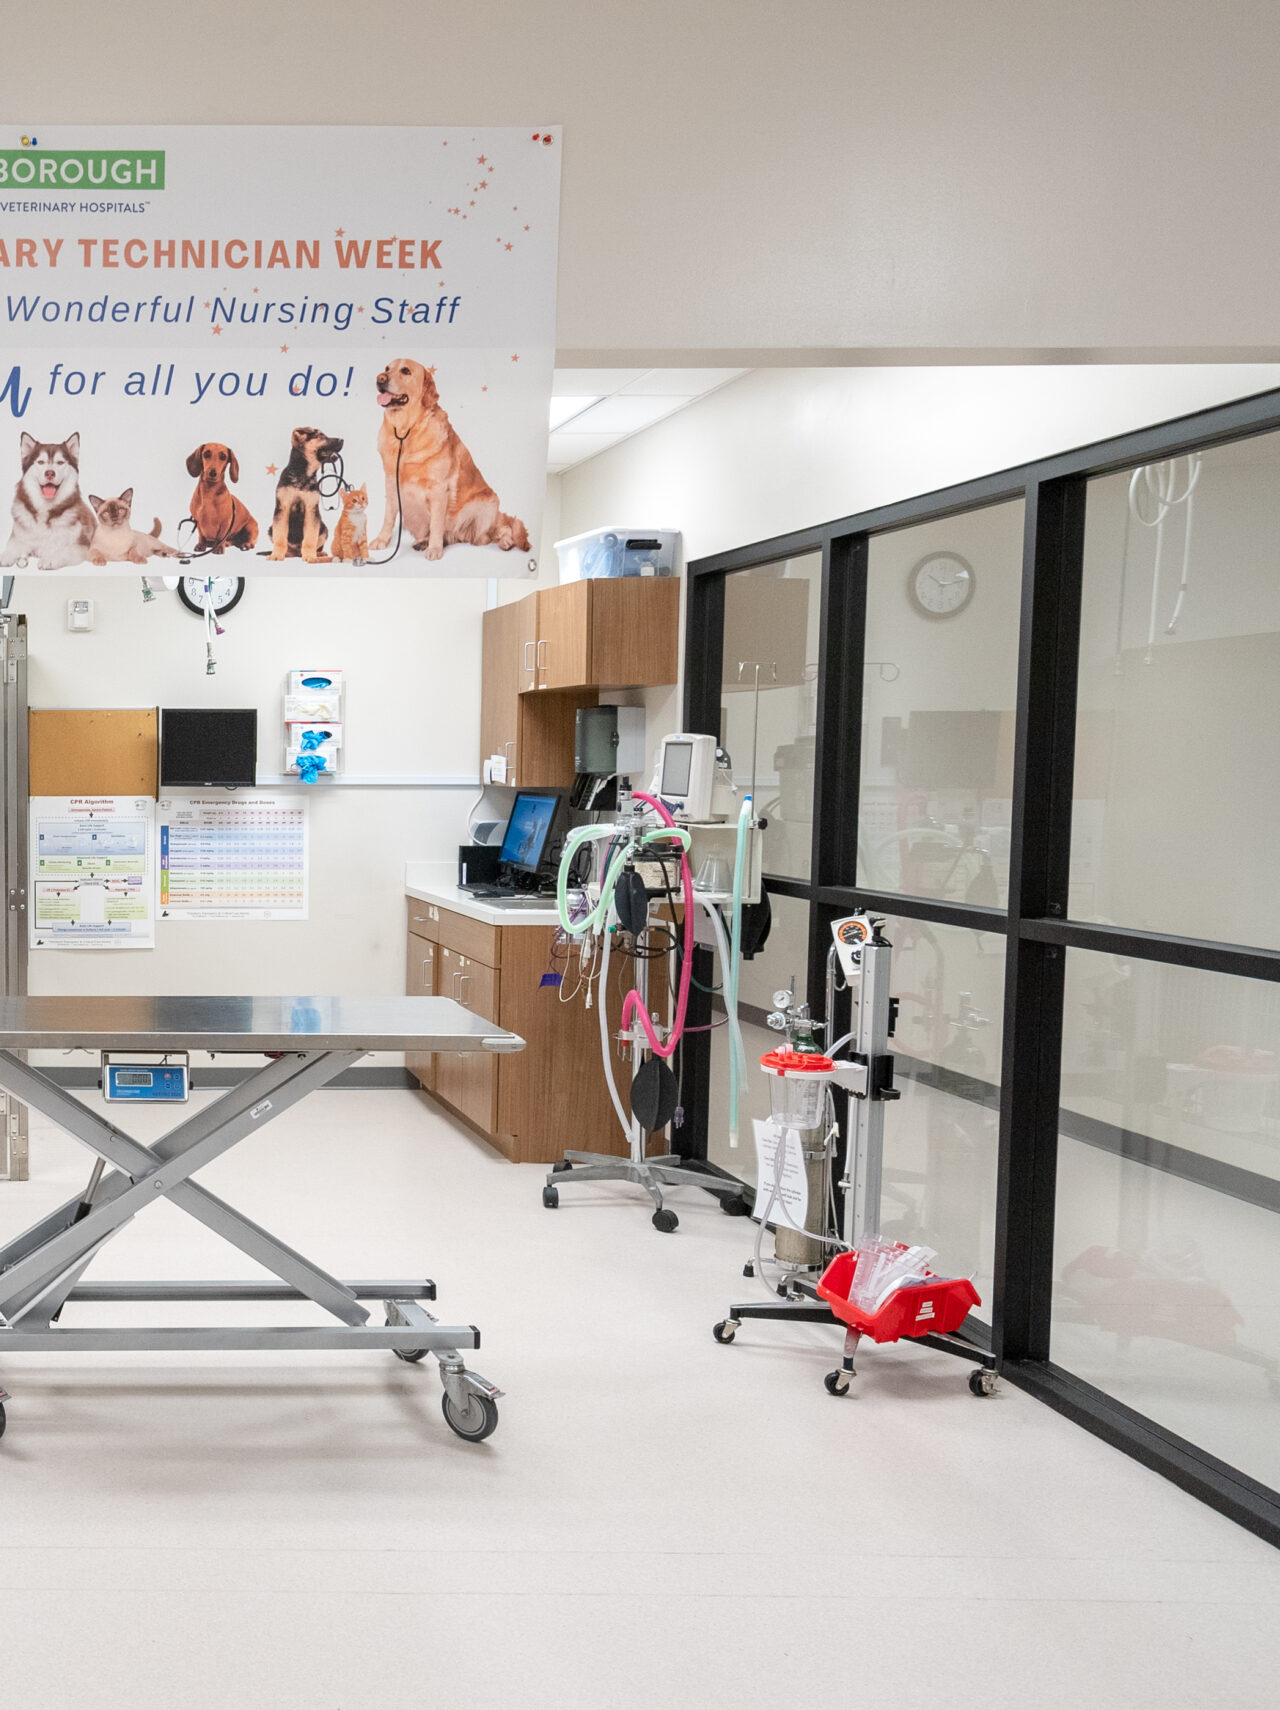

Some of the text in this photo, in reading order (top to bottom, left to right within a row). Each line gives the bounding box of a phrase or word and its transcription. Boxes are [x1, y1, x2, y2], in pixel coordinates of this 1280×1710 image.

[0, 202, 76, 213] VETERINARY
[78, 239, 320, 269] TECHNICIAN
[335, 239, 443, 269] WEEK
[7, 296, 194, 323] Wonderful
[211, 297, 354, 330] Nursing
[371, 296, 461, 324] Staff
[48, 364, 106, 395] for
[124, 364, 175, 395] all
[191, 372, 269, 404] you
[288, 365, 355, 397] do!
[84, 799, 114, 807] Algorithm
